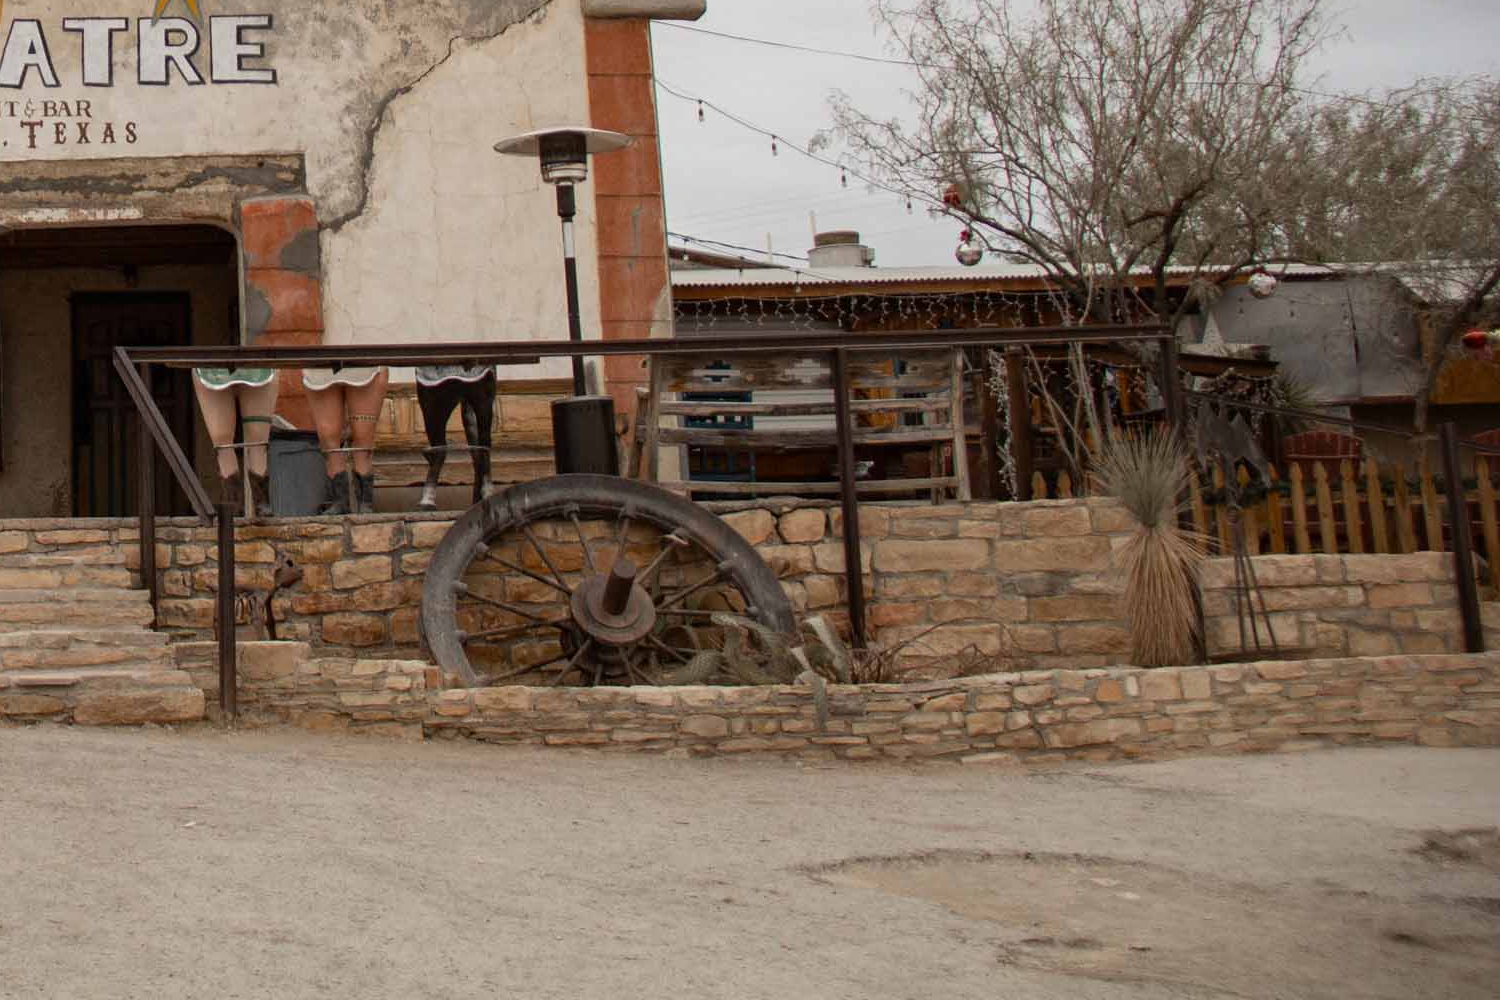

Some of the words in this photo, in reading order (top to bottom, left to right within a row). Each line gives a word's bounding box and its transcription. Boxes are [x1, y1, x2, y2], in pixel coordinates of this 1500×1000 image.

[23, 98, 36, 118] &
[42, 99, 92, 118] BAR
[20, 120, 137, 149] TEXAS
